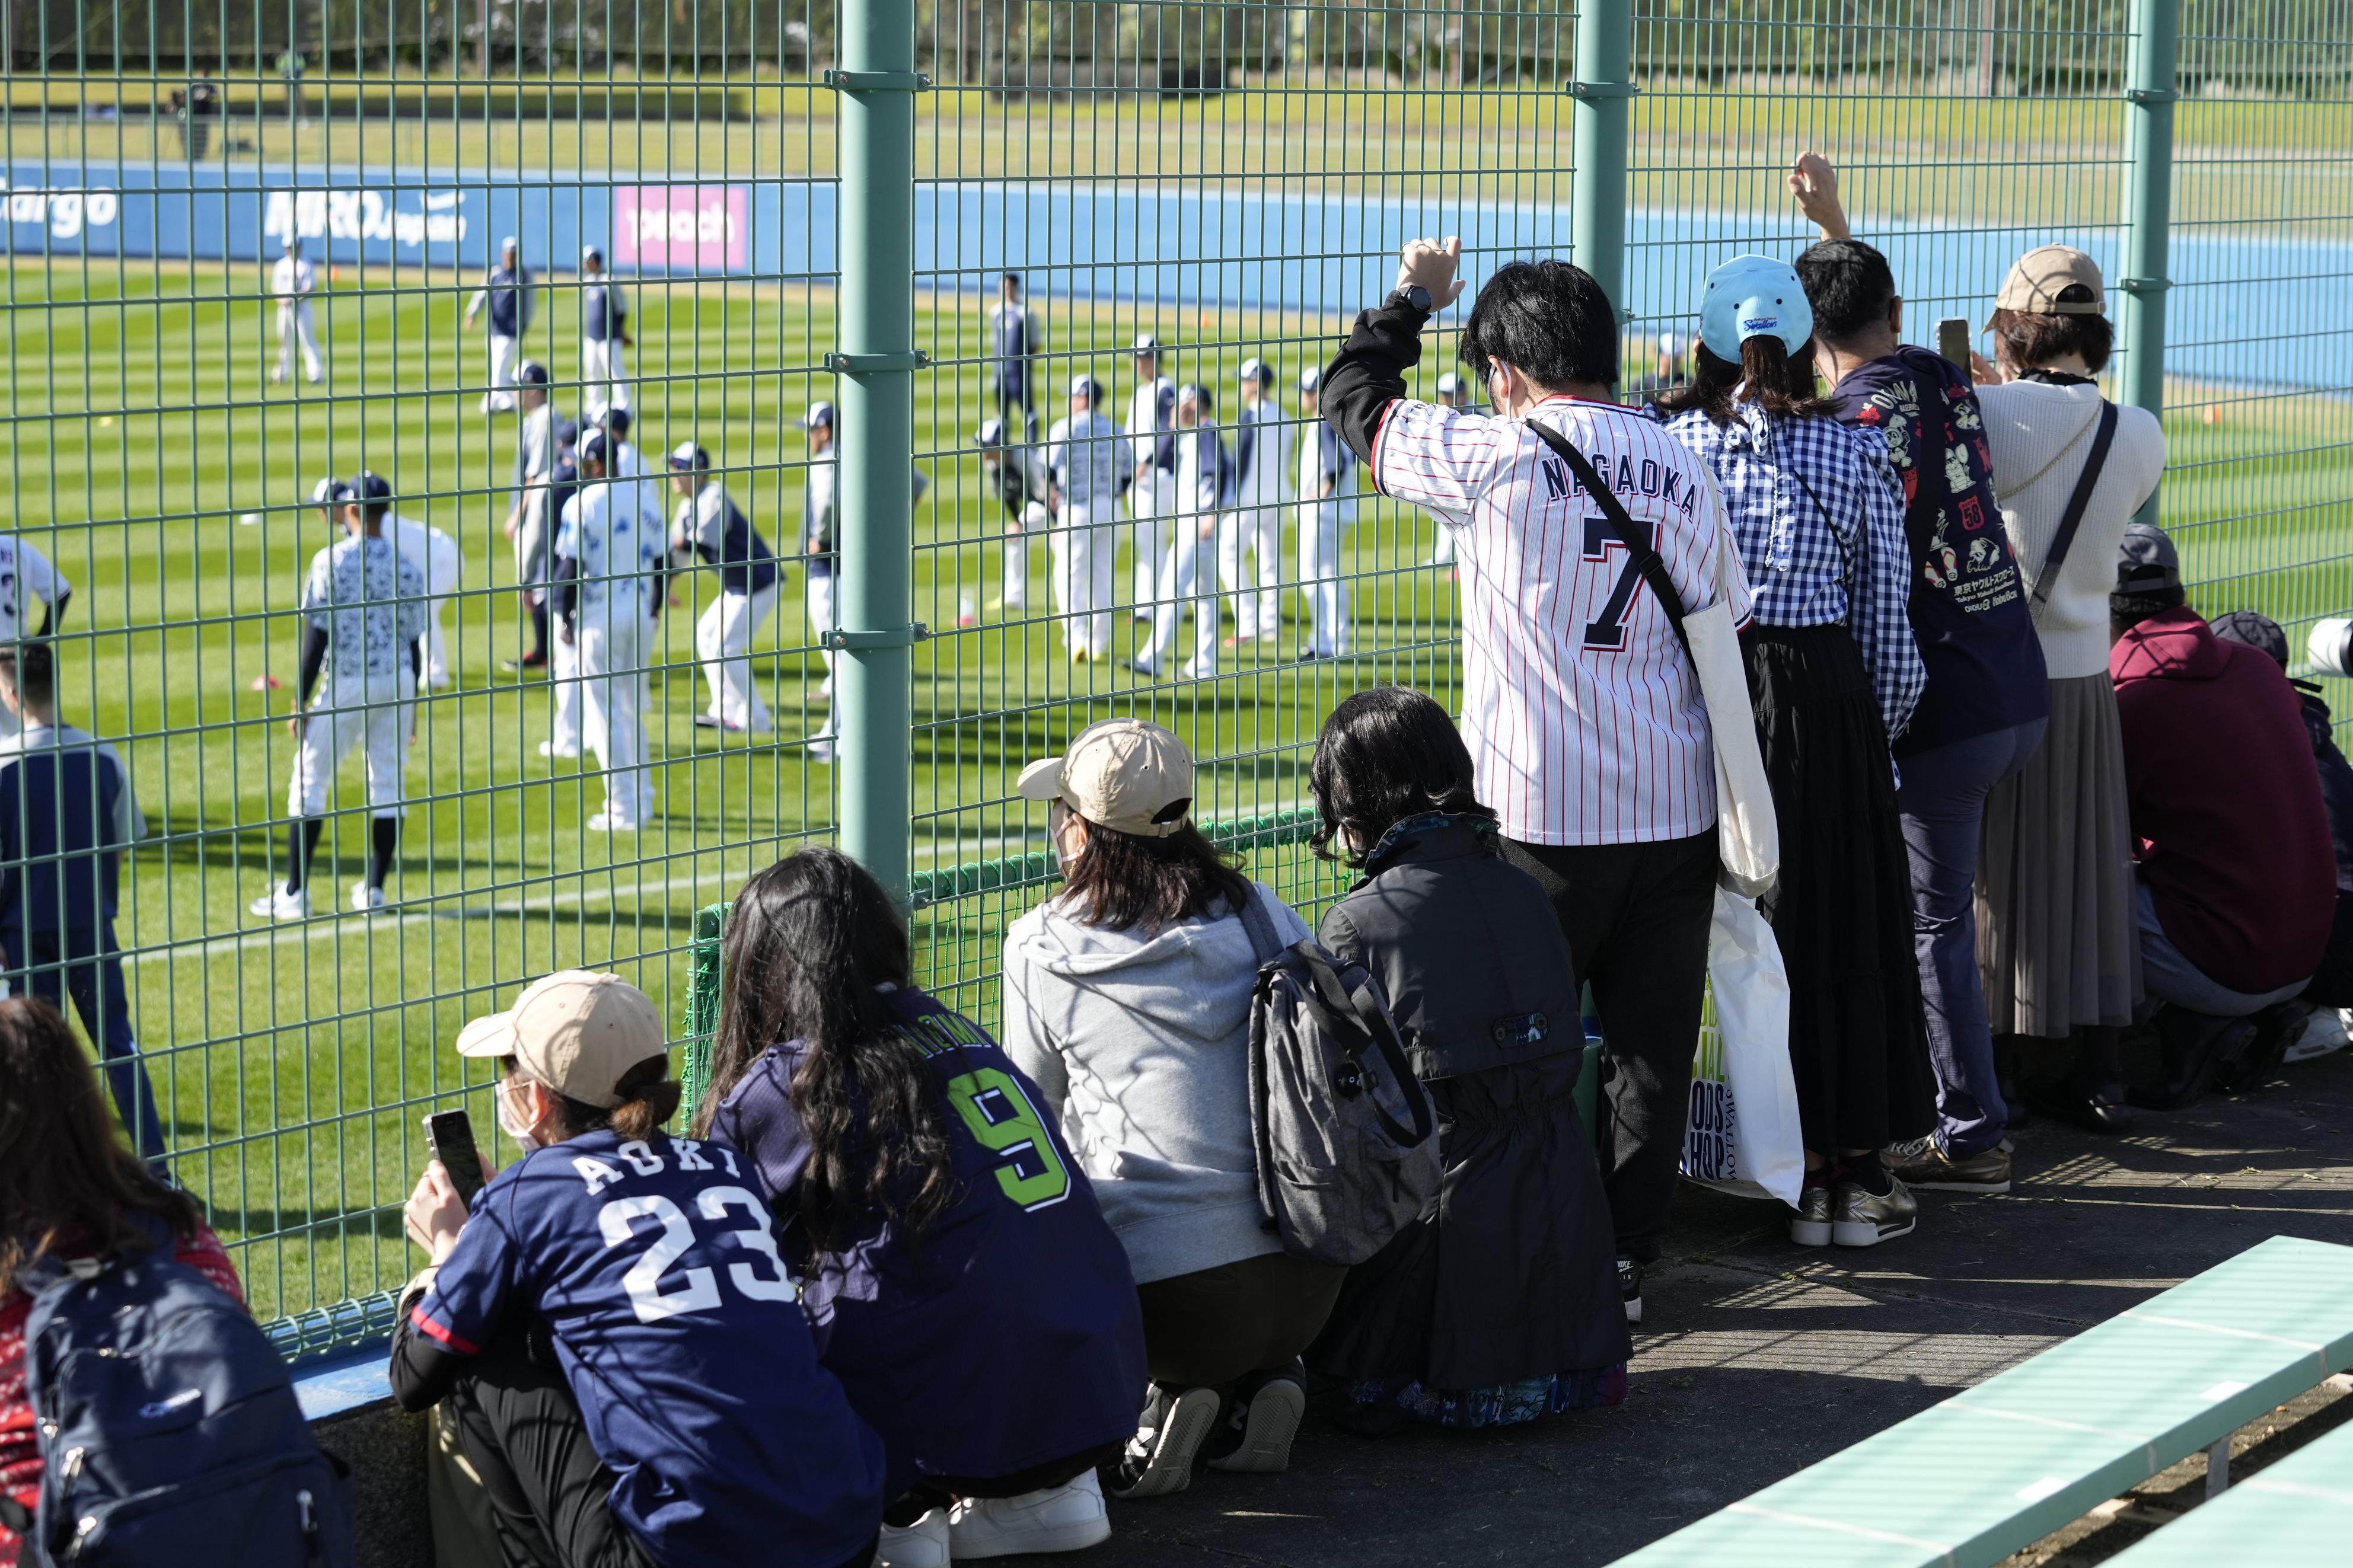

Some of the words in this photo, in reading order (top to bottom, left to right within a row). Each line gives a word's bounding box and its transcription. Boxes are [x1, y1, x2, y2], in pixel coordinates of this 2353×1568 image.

[0, 178, 117, 239] argo
[264, 187, 384, 240] MRO
[626, 200, 736, 250] peach
[1743, 319, 1778, 331] Swallows
[1963, 503, 1982, 528] 58
[1581, 515, 1660, 652] 7
[1955, 595, 1976, 603] Tokyo
[948, 1066, 1072, 1213] 9
[572, 1139, 741, 1196] AOKI
[598, 1185, 797, 1324] 23
